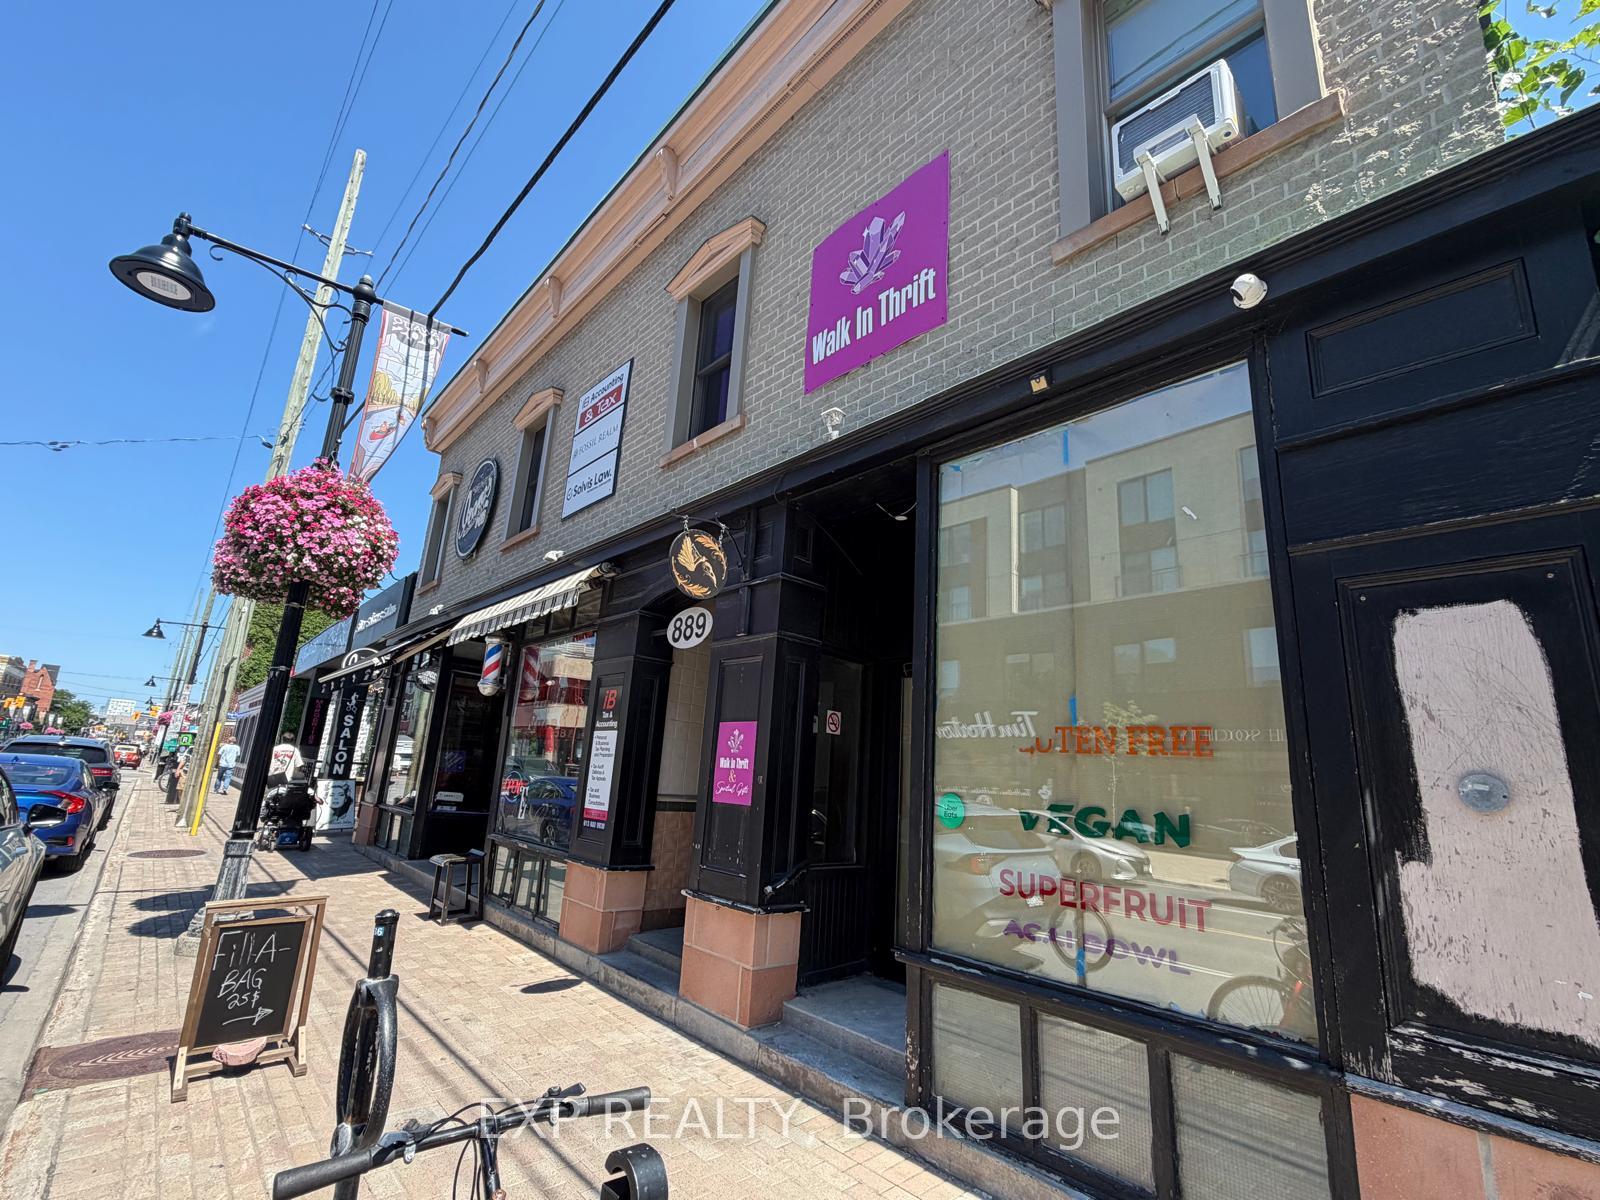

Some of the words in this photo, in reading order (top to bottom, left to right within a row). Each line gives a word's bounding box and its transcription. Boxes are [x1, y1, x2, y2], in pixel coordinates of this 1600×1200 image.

[812, 315, 851, 365] Walk
[856, 306, 873, 340] In
[878, 267, 936, 326] Thrift
[590, 373, 624, 404] Accounting
[584, 408, 593, 423] &
[597, 392, 617, 414] Tax
[671, 612, 707, 643] 889
[595, 720, 618, 729] Accounting
[332, 713, 355, 776] SALON
[1126, 725, 1213, 758] FREE
[728, 769, 737, 783] &
[943, 810, 958, 819] Eats
[1019, 804, 1191, 848] VEGAN
[1000, 868, 1212, 932] SUPERFRUIT
[217, 968, 267, 998] BAG
